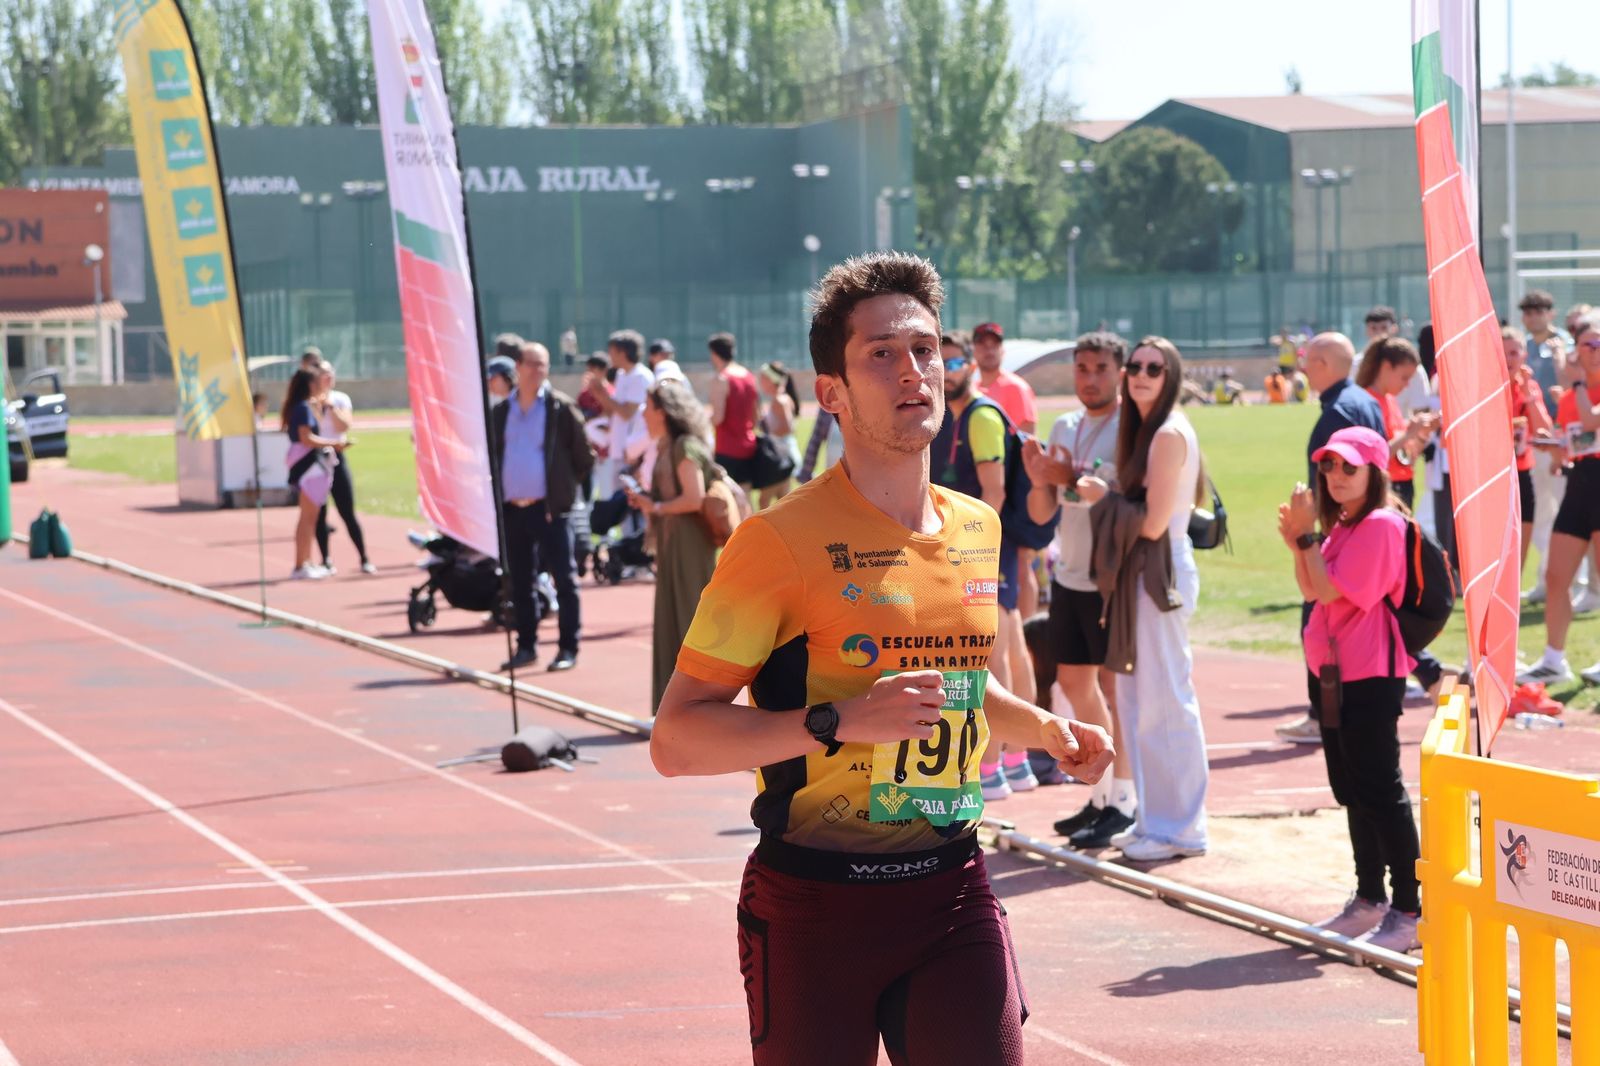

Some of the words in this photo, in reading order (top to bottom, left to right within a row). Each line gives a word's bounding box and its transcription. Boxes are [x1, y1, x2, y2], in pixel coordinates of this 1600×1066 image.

[223, 176, 300, 195] AMORA
[464, 166, 528, 194] AJA
[537, 166, 661, 193] RURAL
[854, 549, 906, 560] Ayuntamiento
[856, 560, 868, 569] de
[870, 558, 909, 568] Salamanca
[881, 635, 955, 650] ESCUELA
[912, 797, 947, 815] CAJA
[850, 856, 940, 874] WONG
[1547, 848, 1591, 873] FEDERACIÓN
[1548, 867, 1558, 883] DE
[1563, 871, 1600, 894] CASTILL
[1551, 889, 1597, 911] DELEGACIÓN
